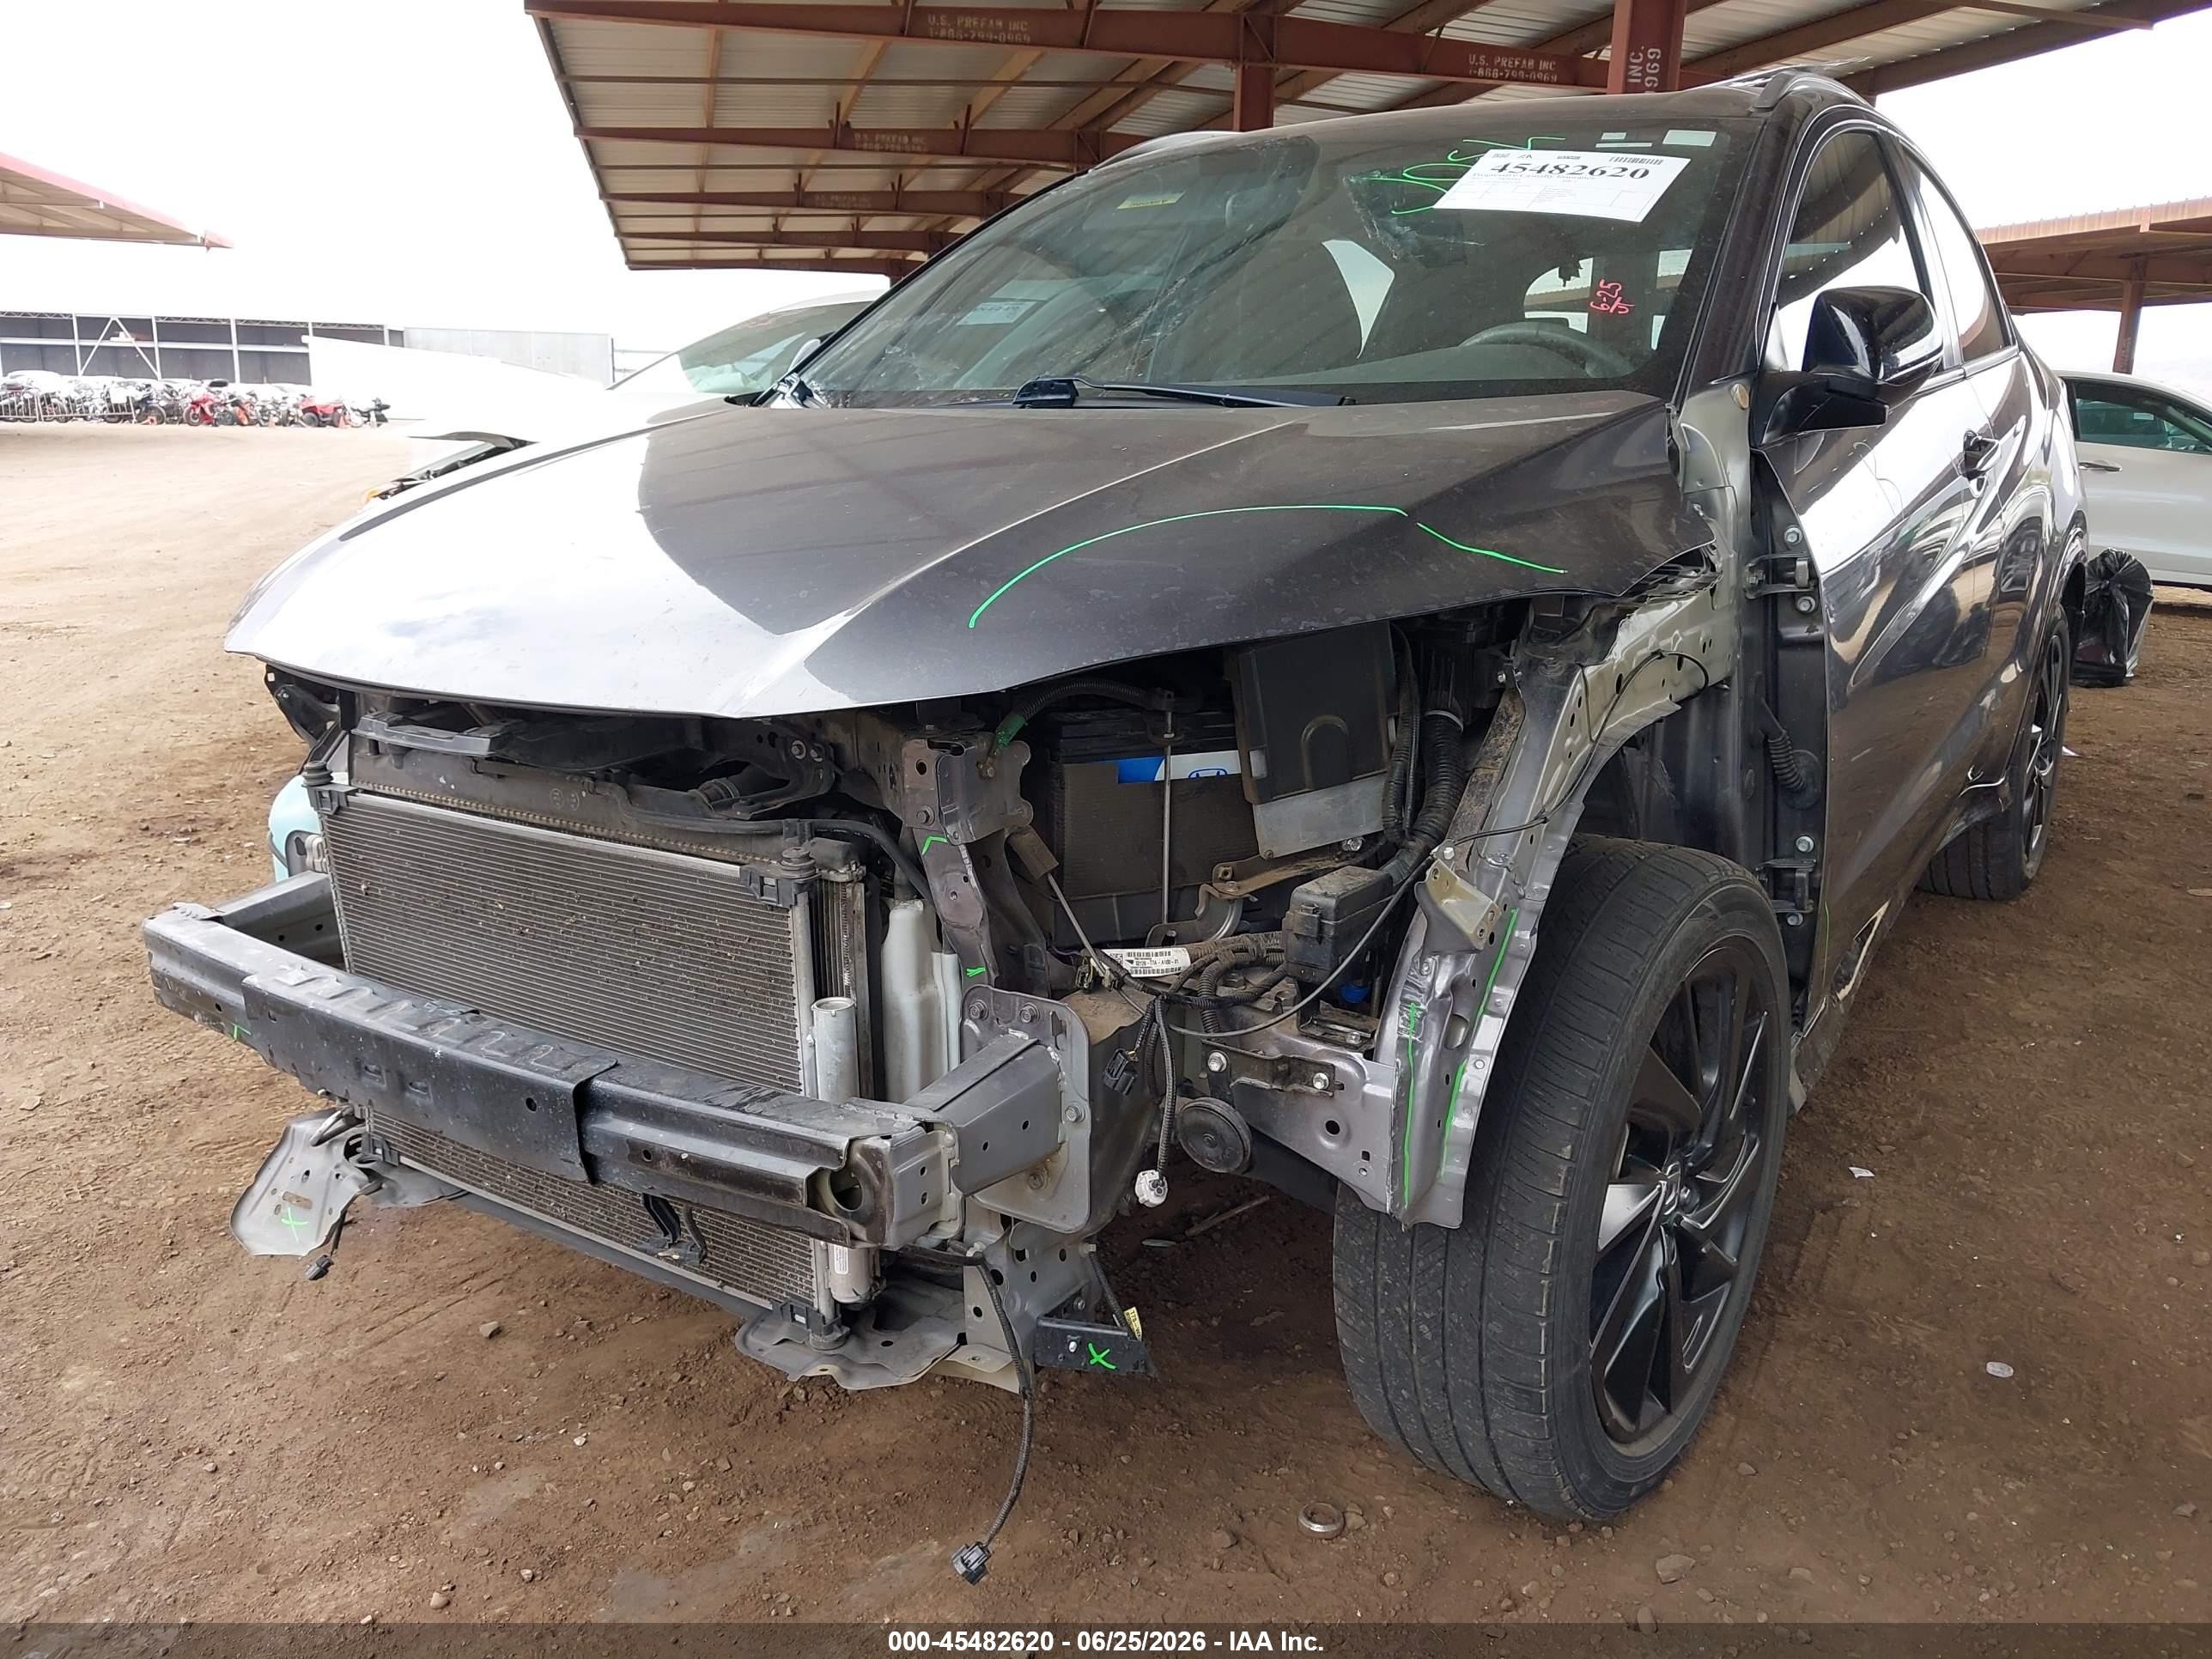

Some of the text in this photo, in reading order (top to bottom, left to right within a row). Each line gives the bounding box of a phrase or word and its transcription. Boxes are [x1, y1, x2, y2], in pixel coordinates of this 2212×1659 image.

[957, 16, 1004, 28] PREFAB
[1008, 20, 1029, 31] INC
[1468, 54, 1557, 70] U.S. PREFAB INC
[1627, 46, 1644, 83] INC.
[1644, 47, 1662, 94] 969
[1491, 162, 1650, 179] 45482620
